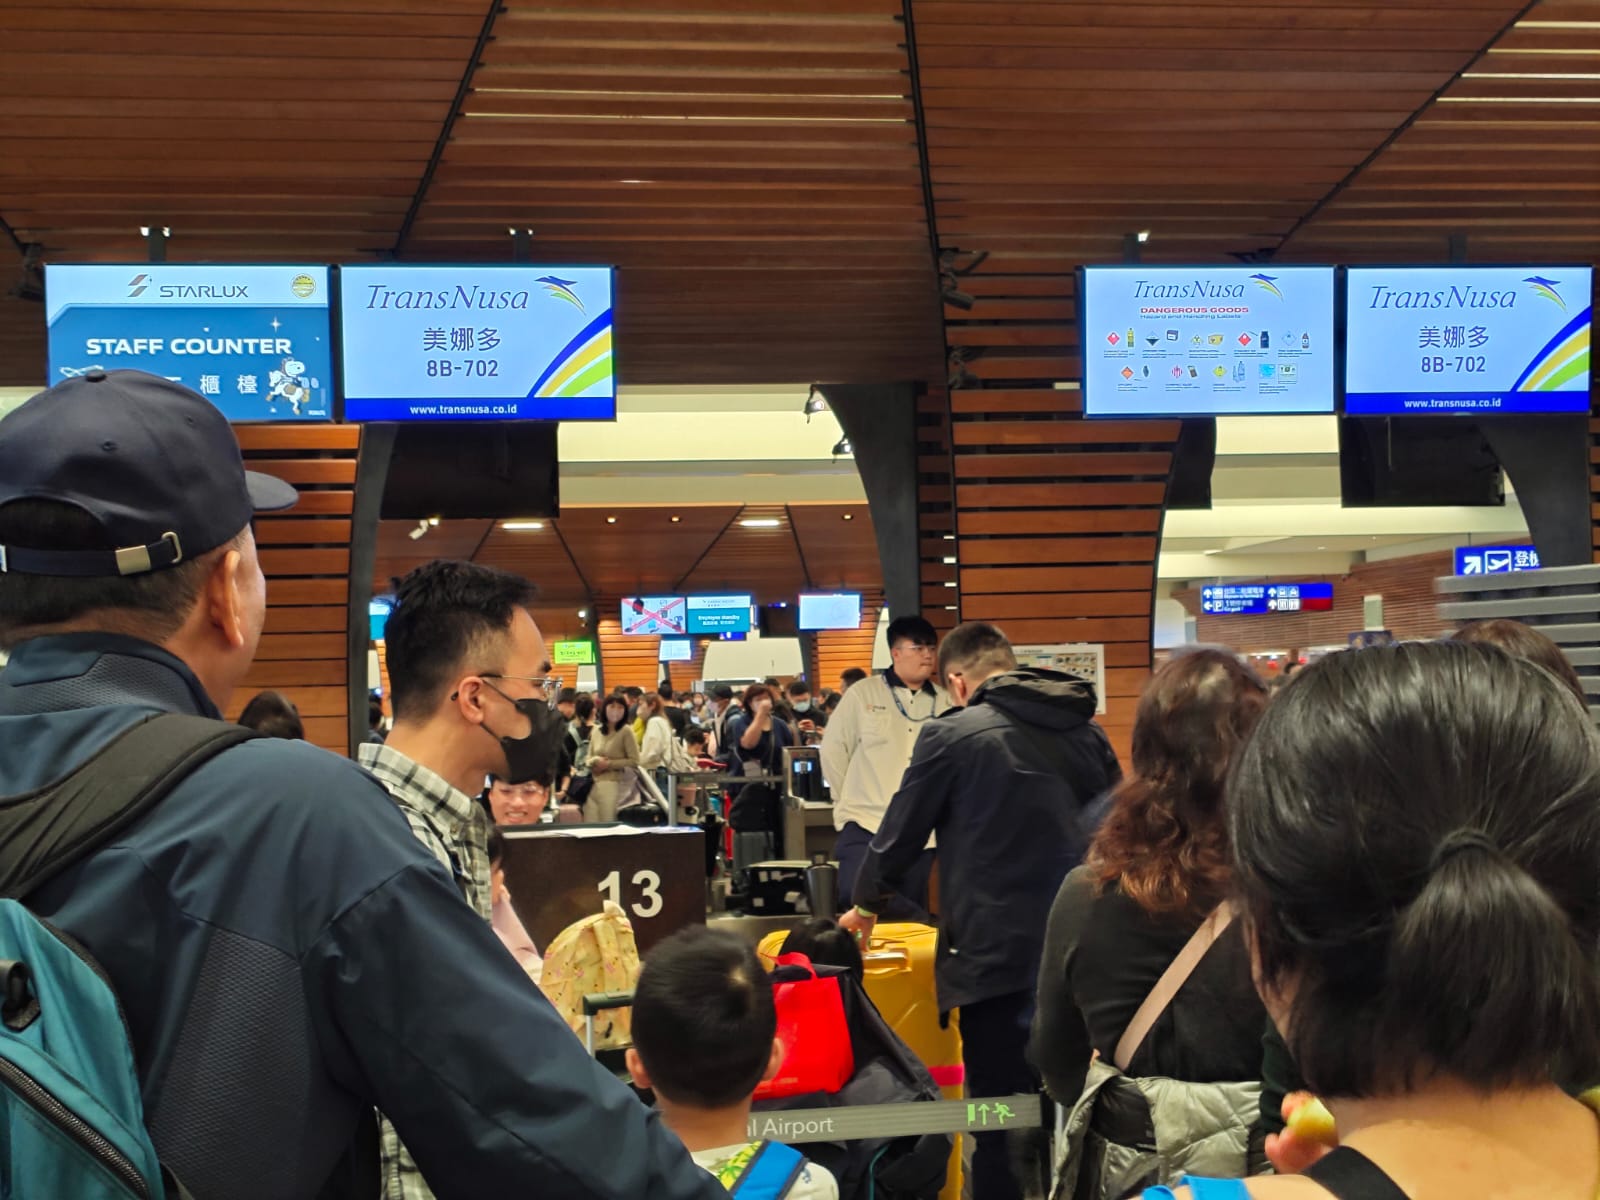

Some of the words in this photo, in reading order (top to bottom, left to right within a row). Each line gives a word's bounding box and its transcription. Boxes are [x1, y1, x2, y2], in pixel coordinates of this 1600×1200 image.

[159, 285, 249, 298] STARLUX
[366, 285, 529, 309] TransNusa
[1134, 280, 1245, 298] TransNusa
[1369, 285, 1517, 309] TransNusa
[423, 327, 500, 352] 美娜多
[1419, 325, 1489, 348] 美娜多
[86, 338, 163, 355] STAFF
[170, 338, 292, 355] COUNTER
[427, 359, 499, 377] 8B-702
[1421, 356, 1486, 373] 8B-702
[410, 403, 518, 415] www.transnusa.co.id
[1404, 398, 1502, 408] www.transnusa.co.id
[597, 869, 663, 918] 13
[762, 1117, 834, 1140] Airport
